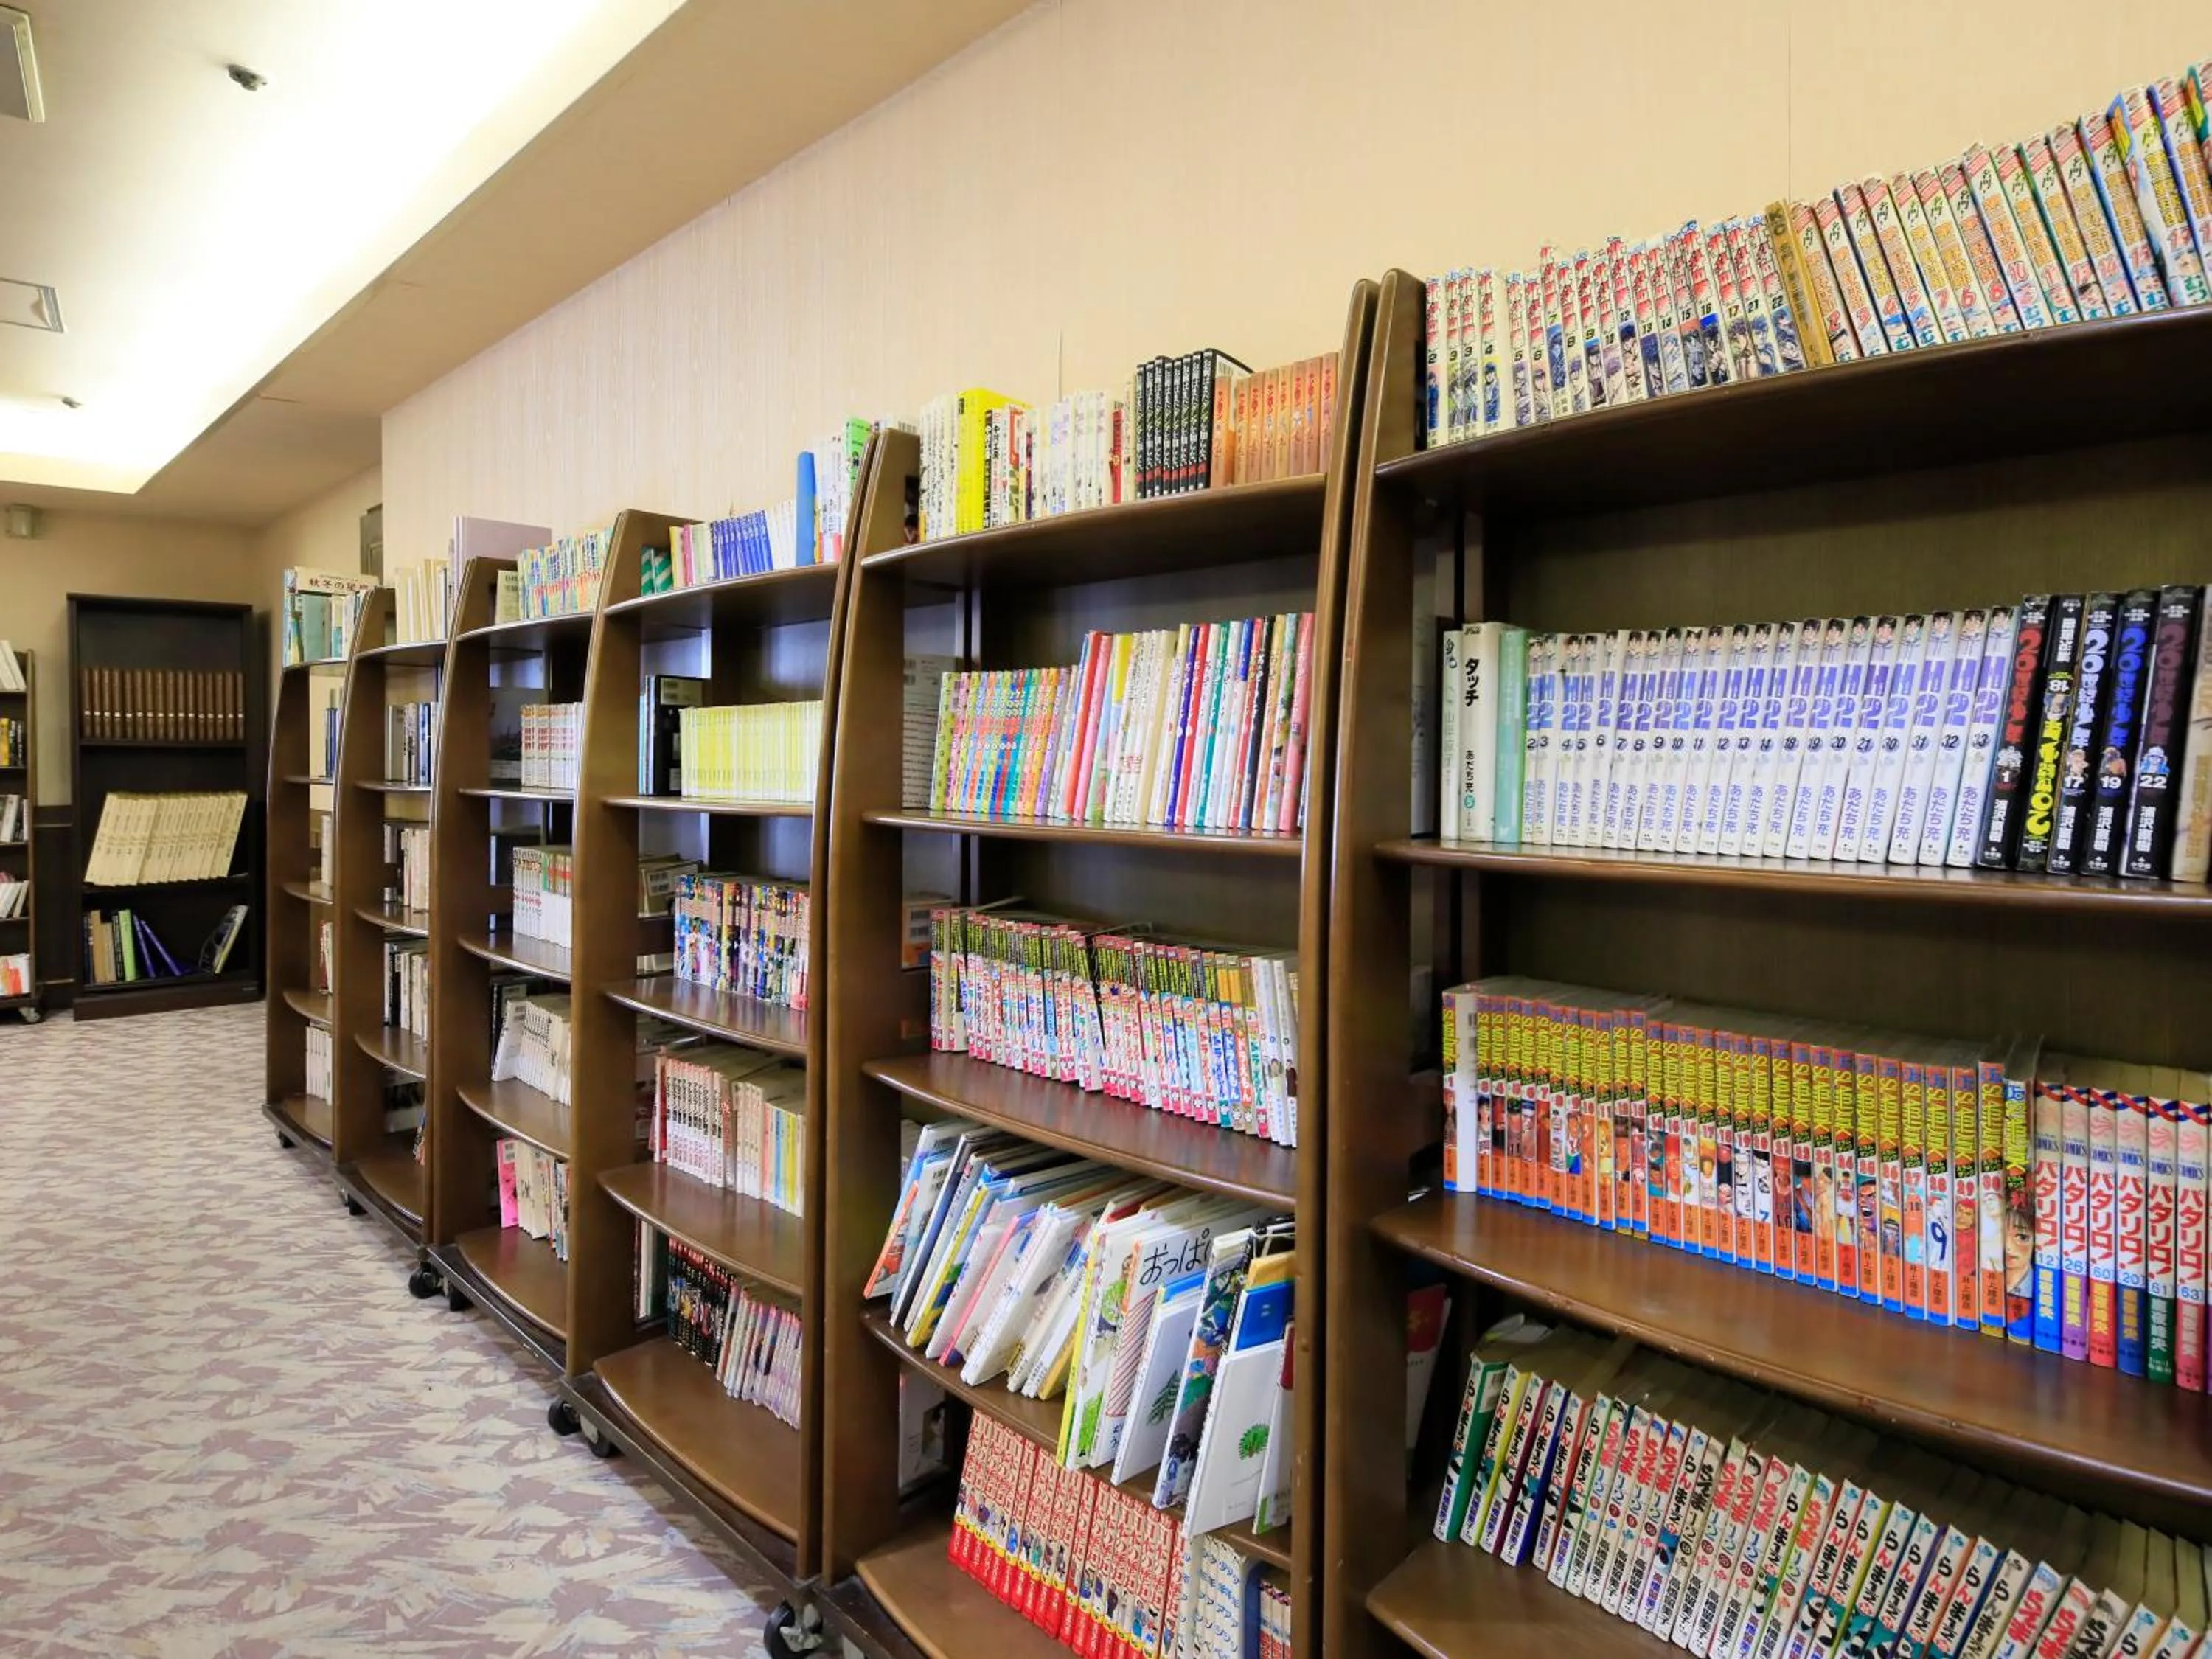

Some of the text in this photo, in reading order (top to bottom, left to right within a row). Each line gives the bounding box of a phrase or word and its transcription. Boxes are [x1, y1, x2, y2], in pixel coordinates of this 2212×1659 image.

[1464, 658, 1480, 706] タッチ
[1562, 675, 1579, 731] H2
[1578, 675, 1594, 731] H2
[1598, 671, 1615, 726] H2
[1617, 674, 1637, 730] H2
[1635, 674, 1656, 731] H2
[1654, 671, 1677, 728] H2
[1673, 671, 1696, 730] H2
[1693, 670, 1717, 730] H2
[1717, 670, 1742, 730] H2
[1739, 668, 1764, 728] H2
[1762, 668, 1787, 728] H2
[1786, 665, 1813, 728] H2
[1809, 667, 1837, 728] H2
[1834, 665, 1862, 727] H2
[1860, 665, 1889, 729] H2
[1884, 664, 1916, 728] H2
[1913, 661, 1946, 726] H2
[1943, 659, 1976, 726] H2
[1972, 656, 2006, 723] H2
[2050, 679, 2070, 692] 18
[2071, 629, 2110, 747] 20世紀少年
[2109, 626, 2147, 747] 20世紀少年
[1527, 738, 1536, 750] 2
[1540, 736, 1548, 747] 3
[1562, 739, 1571, 750] 4
[1577, 739, 1586, 749] 5
[1596, 734, 1605, 746] 6
[1617, 738, 1627, 750] 7
[1634, 739, 1644, 751] 8
[1654, 737, 1665, 748] 9
[1694, 737, 1704, 749] 11
[1717, 737, 1729, 750] 12
[1832, 737, 1846, 749] 20
[1857, 737, 1871, 752] 21
[1912, 735, 1927, 749] 31
[1941, 734, 1959, 749] 32
[1465, 750, 1475, 793] あだち充
[2002, 771, 2010, 782] 1
[2064, 776, 2084, 788] 17
[2101, 776, 2121, 789] 19
[2139, 775, 2167, 790] 22
[2036, 1161, 2057, 1251] パタリロ!
[2064, 1166, 2086, 1256] パタリロ!
[2090, 1173, 2113, 1265] パタリロ!
[2119, 1176, 2143, 1269] パタリロ!
[2149, 1184, 2172, 1279] パタリロ!
[2039, 1253, 2054, 1265] 12
[2180, 1188, 2204, 1284] パタリロ!
[2065, 1259, 2083, 1273] 26
[2093, 1266, 2112, 1280] 60
[2122, 1272, 2140, 1285] 20
[2152, 1281, 2167, 1296] 61
[2180, 1286, 2200, 1300] 63
